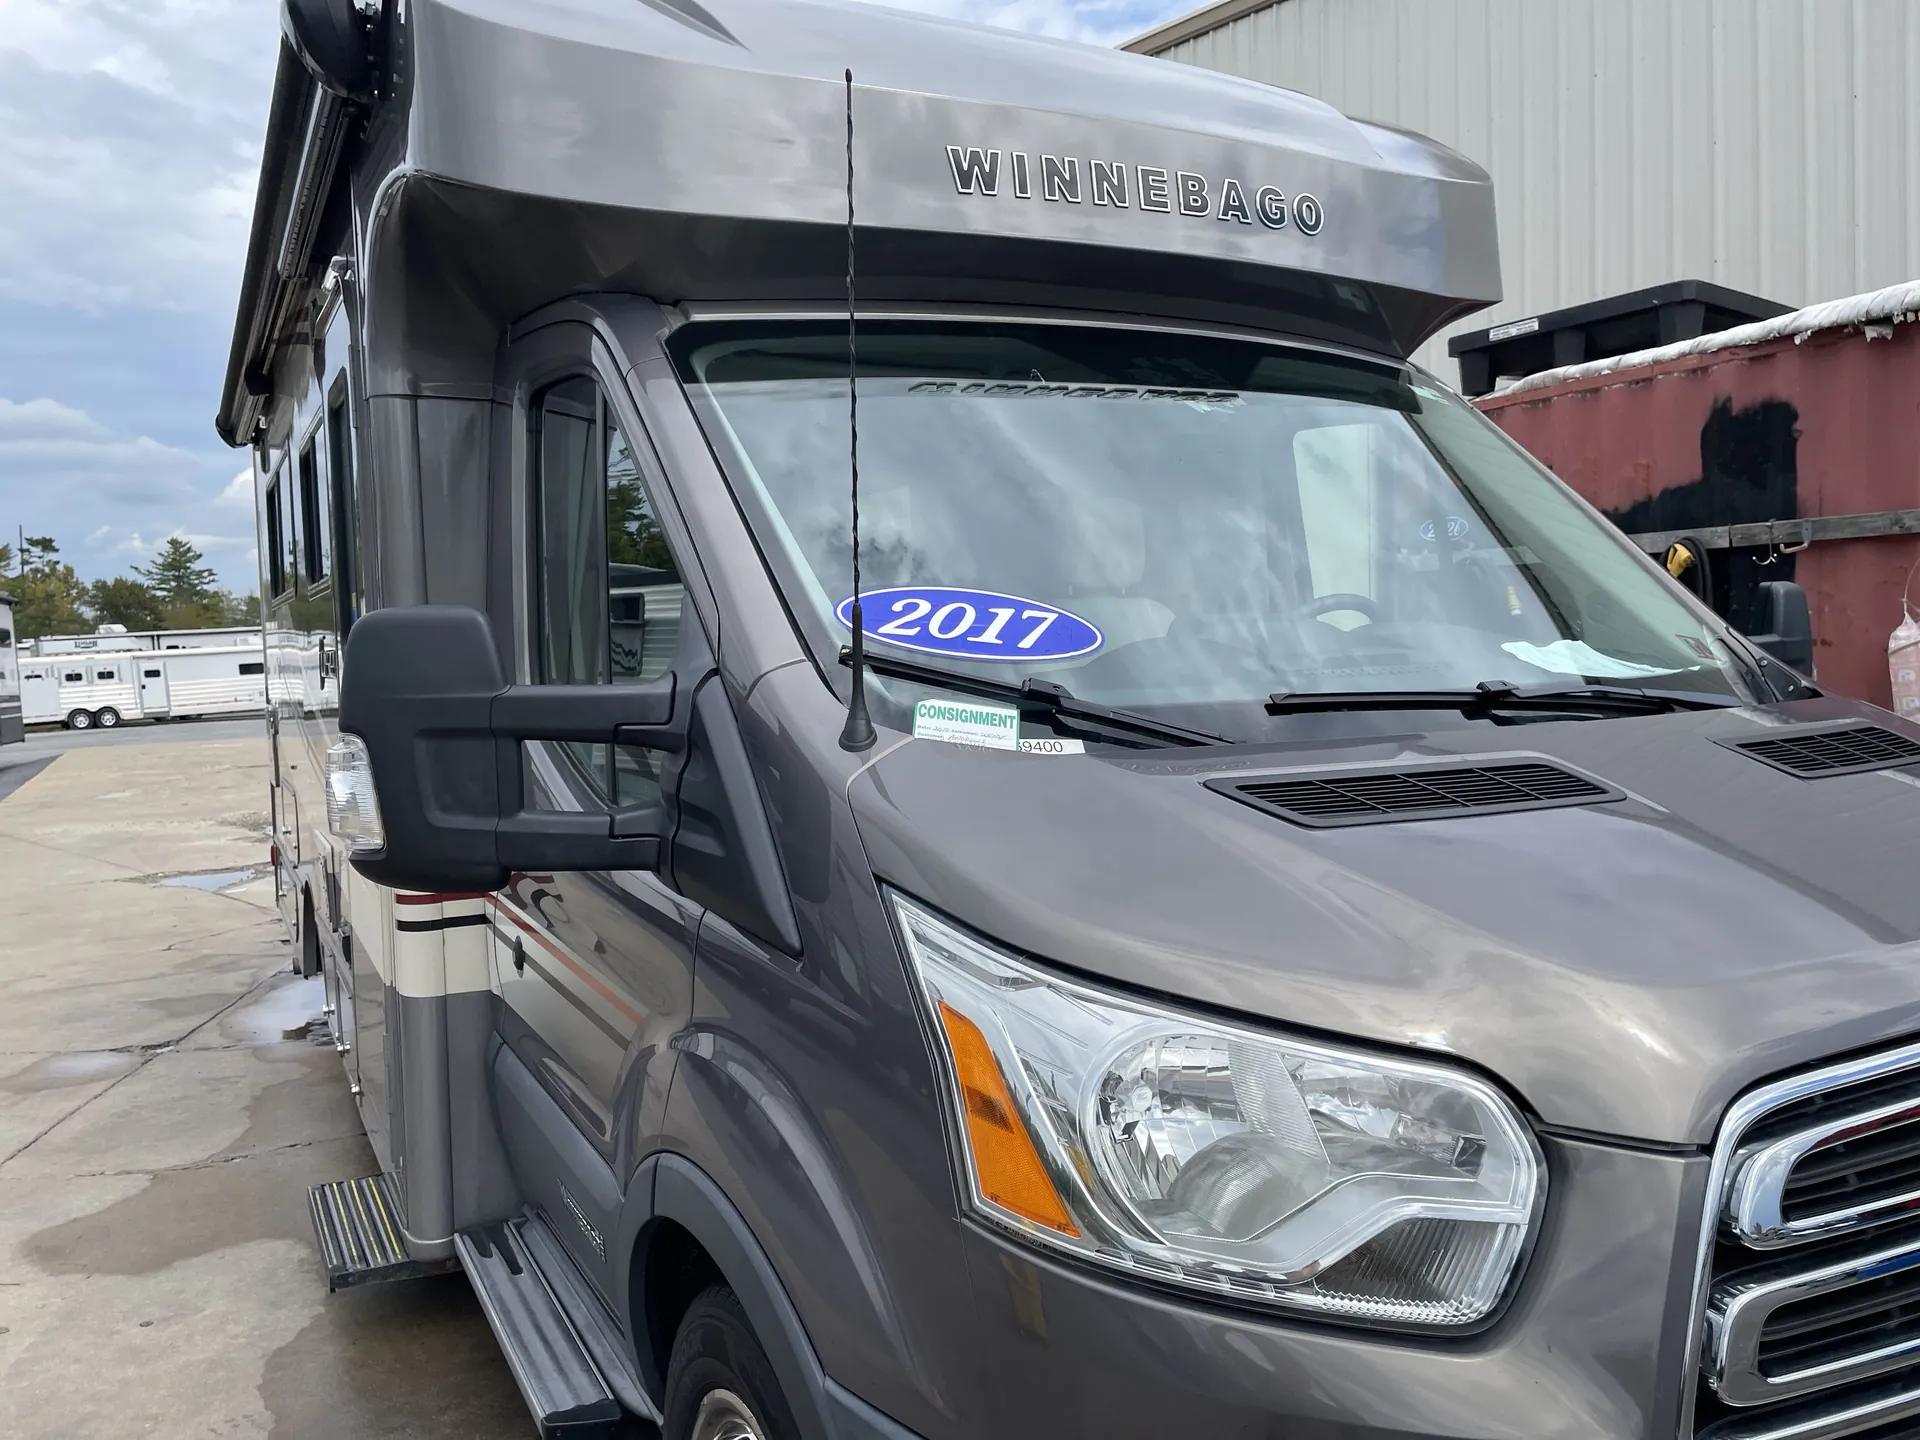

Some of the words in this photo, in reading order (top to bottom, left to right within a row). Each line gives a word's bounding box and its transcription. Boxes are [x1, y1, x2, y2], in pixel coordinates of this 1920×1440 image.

[946, 144, 1325, 236] WINNEBAGO
[877, 598, 1059, 649] 2017
[918, 703, 1016, 729] CONSIGNMENT
